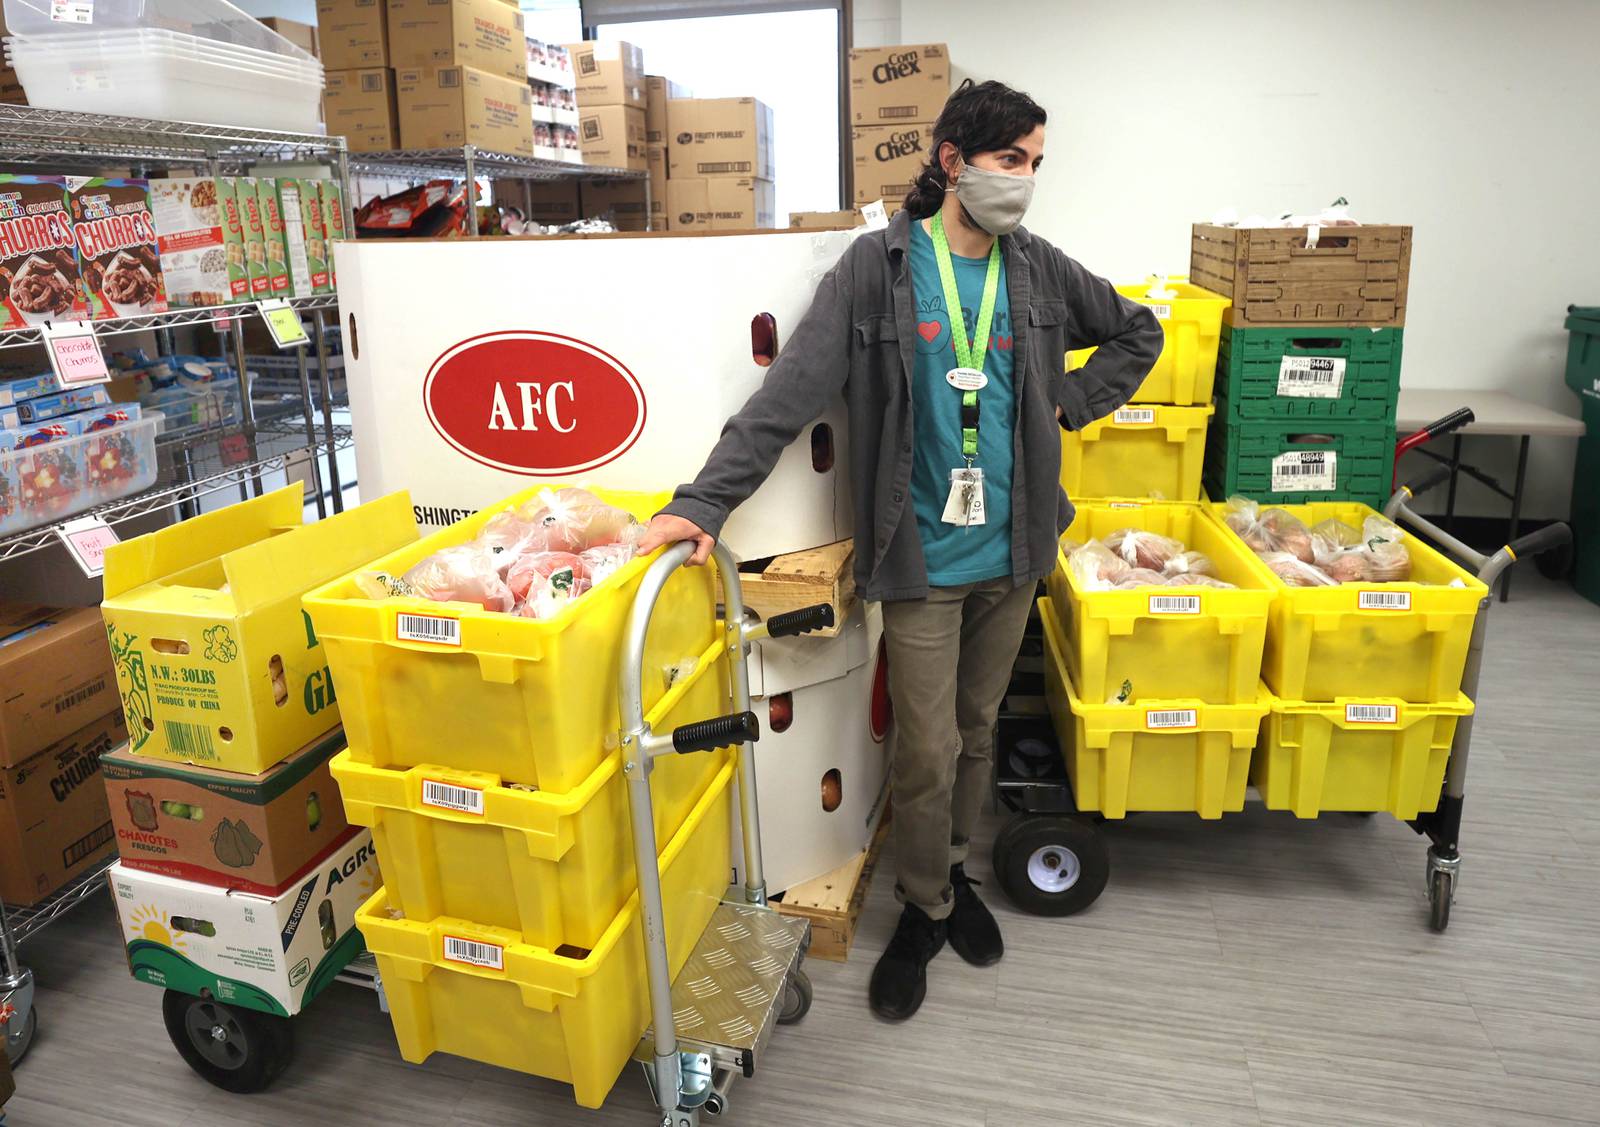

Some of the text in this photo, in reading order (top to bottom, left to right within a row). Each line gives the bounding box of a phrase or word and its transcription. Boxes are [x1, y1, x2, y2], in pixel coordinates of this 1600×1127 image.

[888, 51, 918, 65] Corn
[872, 60, 921, 84] Chex
[695, 131, 715, 139] FRUITY
[890, 130, 920, 144] Corn
[875, 138, 923, 162] Chex
[26, 200, 63, 215] CHOCOLATE
[225, 196, 241, 234] Chex
[246, 196, 262, 232] Chex
[266, 196, 282, 232] Chex
[308, 198, 322, 232] Chex
[74, 210, 158, 262] CHURROS
[488, 381, 577, 433] AFC
[413, 506, 479, 526] SHINGT
[181, 668, 216, 684] 30LBS
[157, 696, 220, 710] PRODUCE OF CHINA
[118, 830, 178, 849] CHAYOTES
[132, 842, 167, 854] FRESCOS
[284, 890, 310, 935] PRE-COOLED
